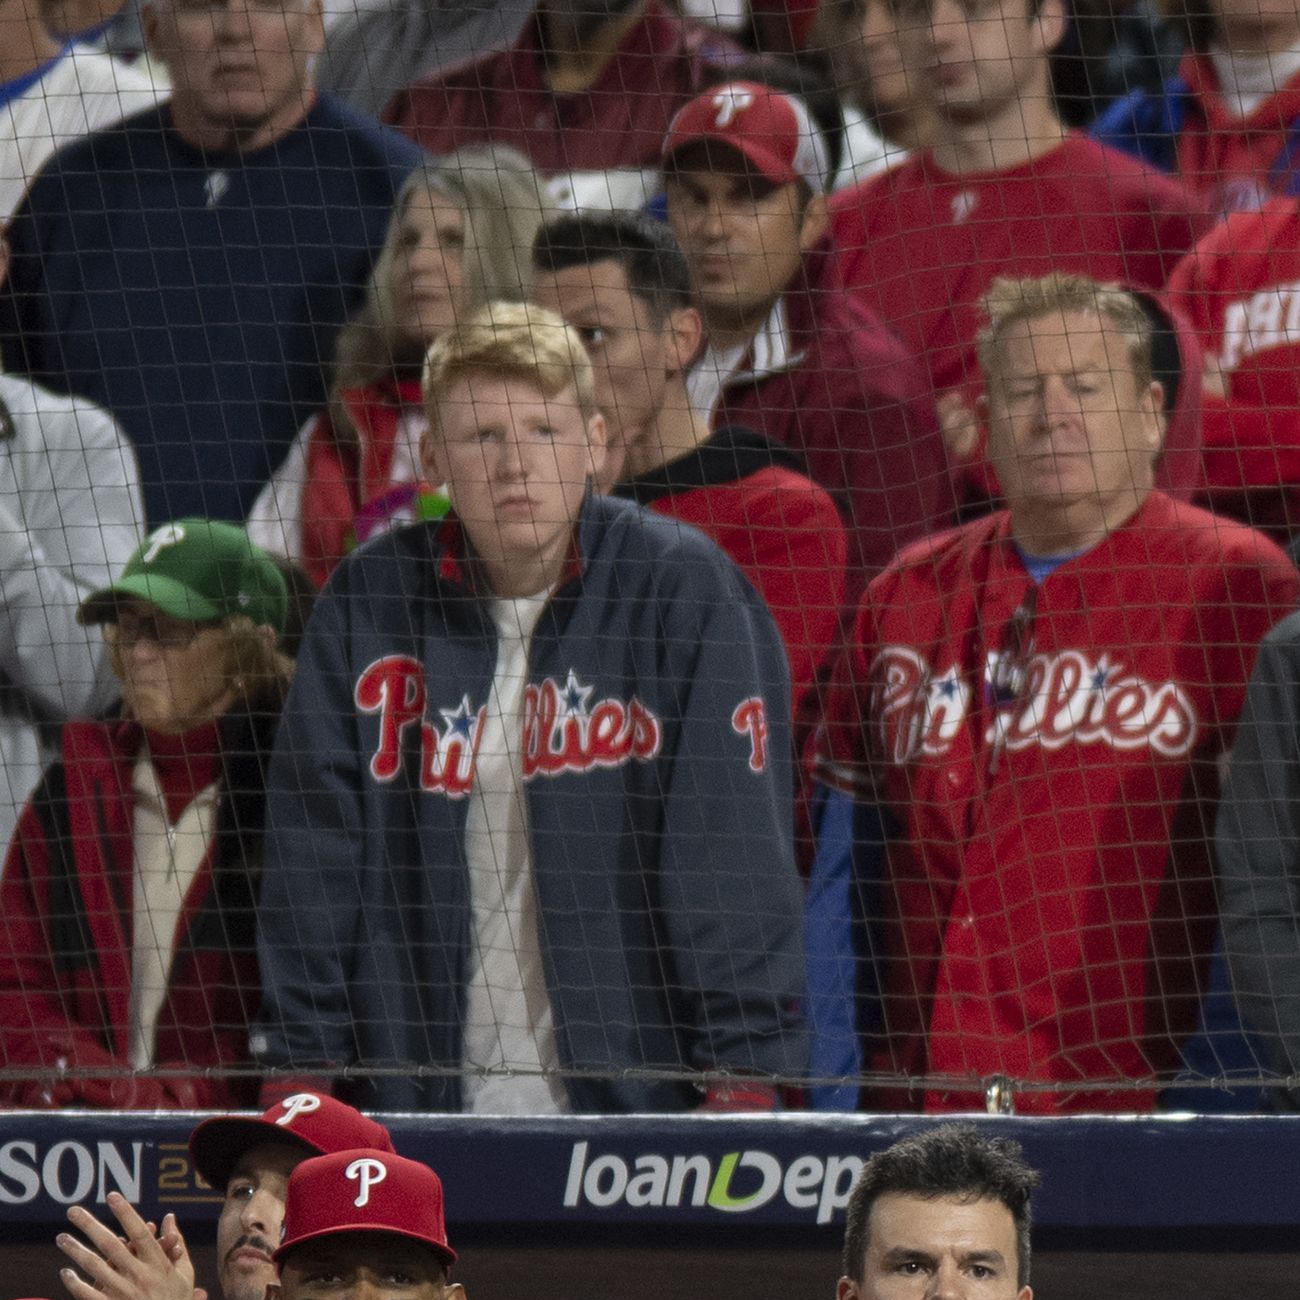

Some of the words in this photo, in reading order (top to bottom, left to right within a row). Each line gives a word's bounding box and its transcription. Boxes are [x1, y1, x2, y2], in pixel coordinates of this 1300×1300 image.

[142, 526, 187, 563] P
[731, 697, 767, 774] P
[274, 1093, 321, 1127] P
[0, 1141, 144, 1203] SON
[159, 1157, 212, 1190] 2
[344, 1157, 388, 1207] P
